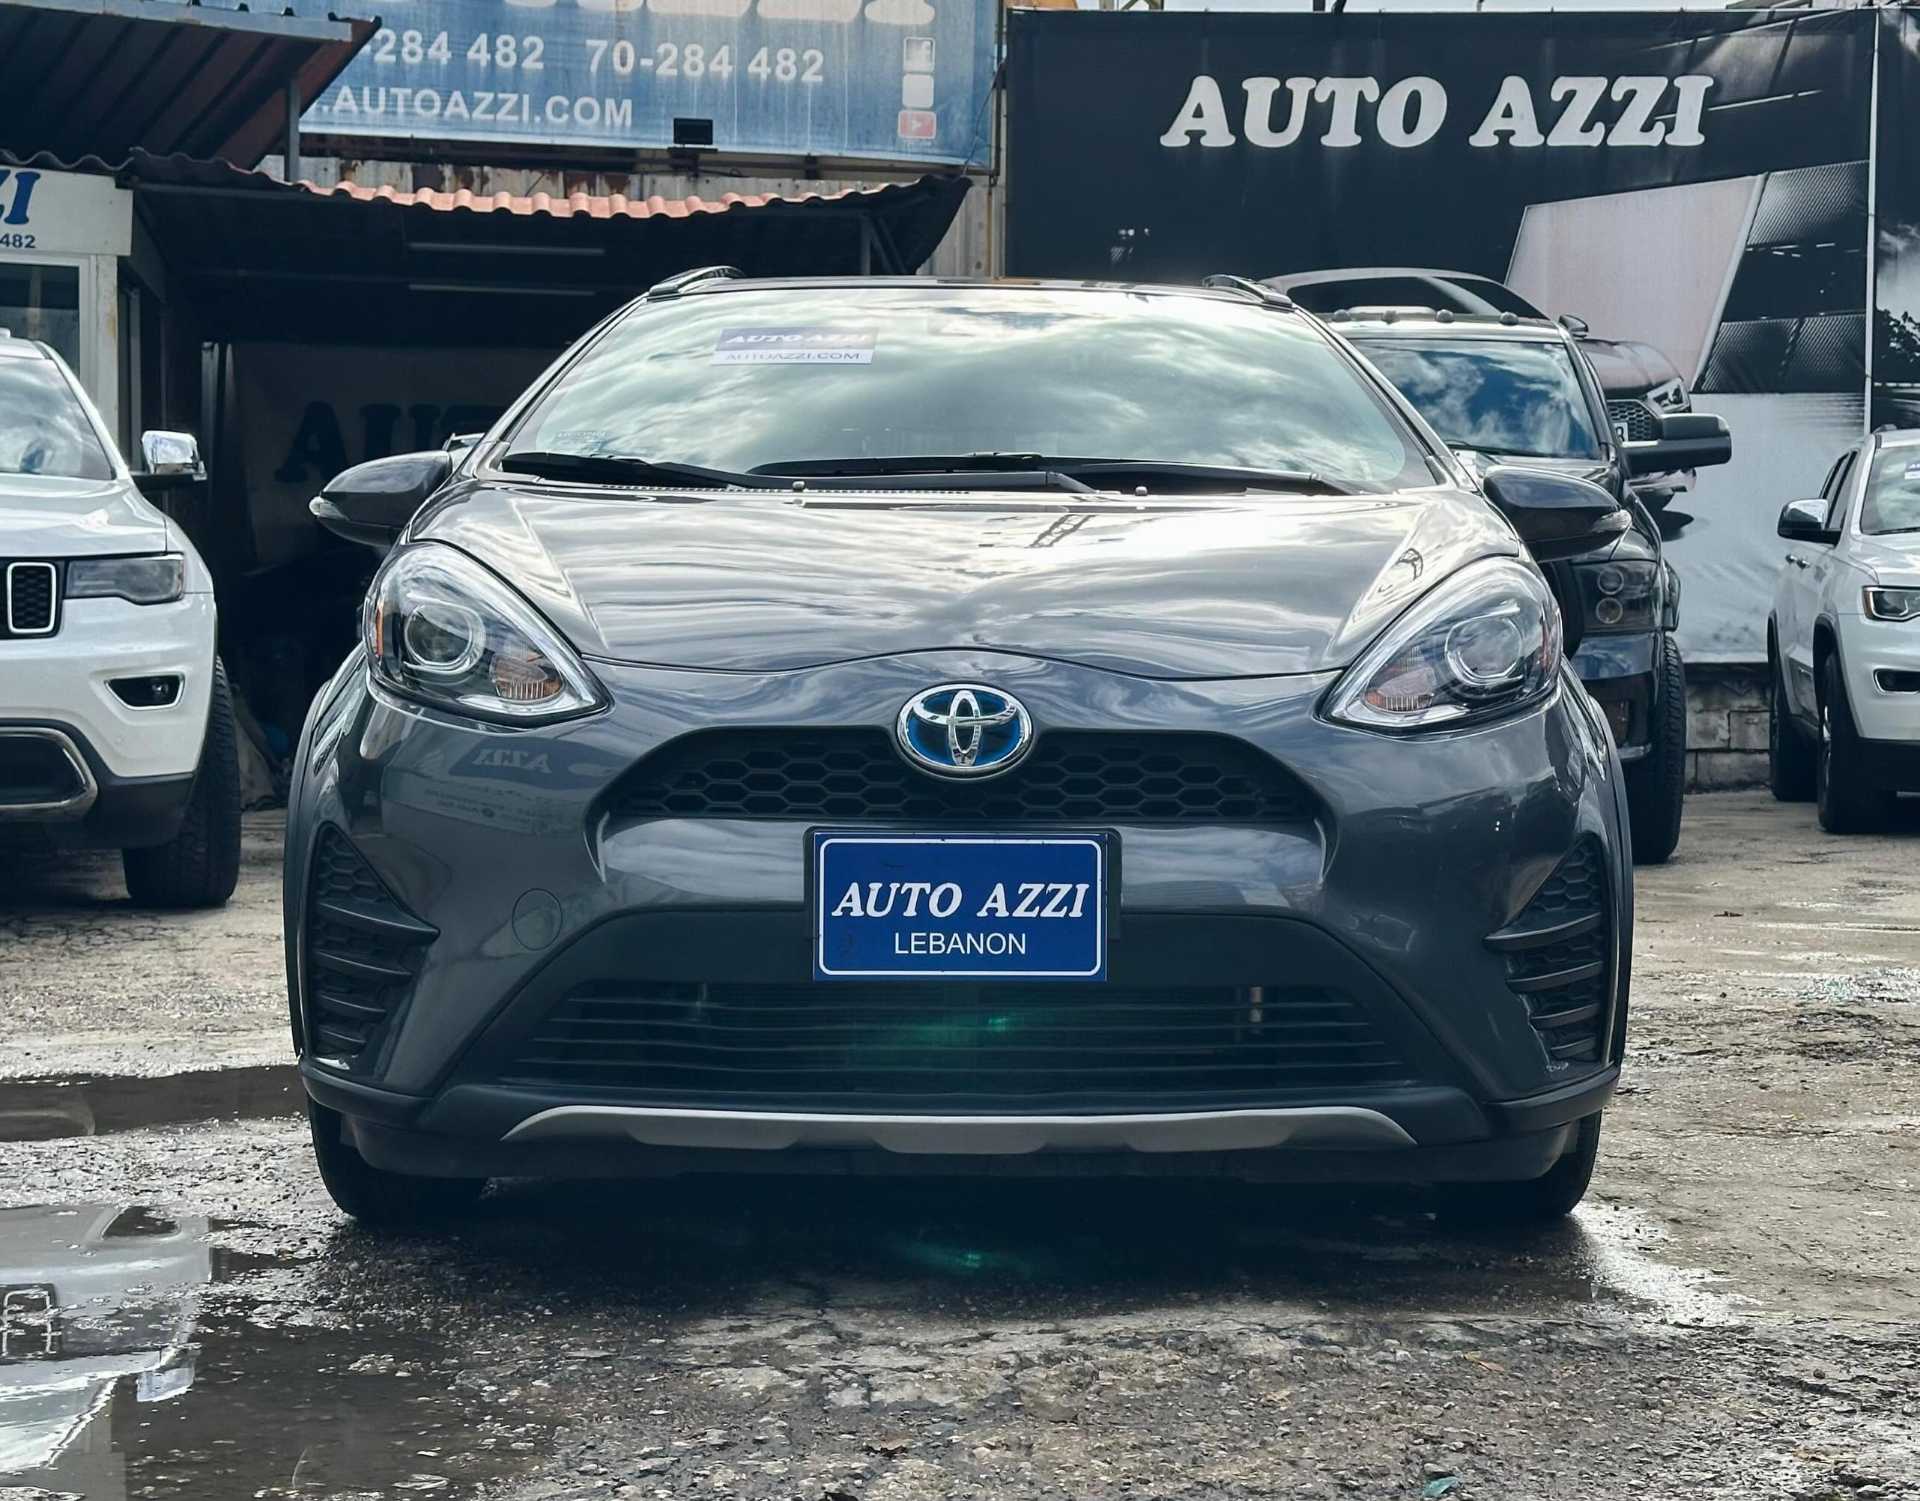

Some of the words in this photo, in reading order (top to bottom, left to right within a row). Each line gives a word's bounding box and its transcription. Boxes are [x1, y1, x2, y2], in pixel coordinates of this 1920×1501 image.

[466, 33, 545, 69] 482
[586, 39, 734, 80] 70-284
[747, 47, 825, 82] 482
[1160, 75, 1448, 148] AUTO
[1469, 75, 1717, 148] AZZI
[725, 334, 803, 344] AUTO
[726, 352, 861, 361] AUTOAZZI.COM
[831, 882, 963, 918] AUTO
[976, 883, 1090, 918] AZZI
[894, 932, 1027, 955] LEBANON
